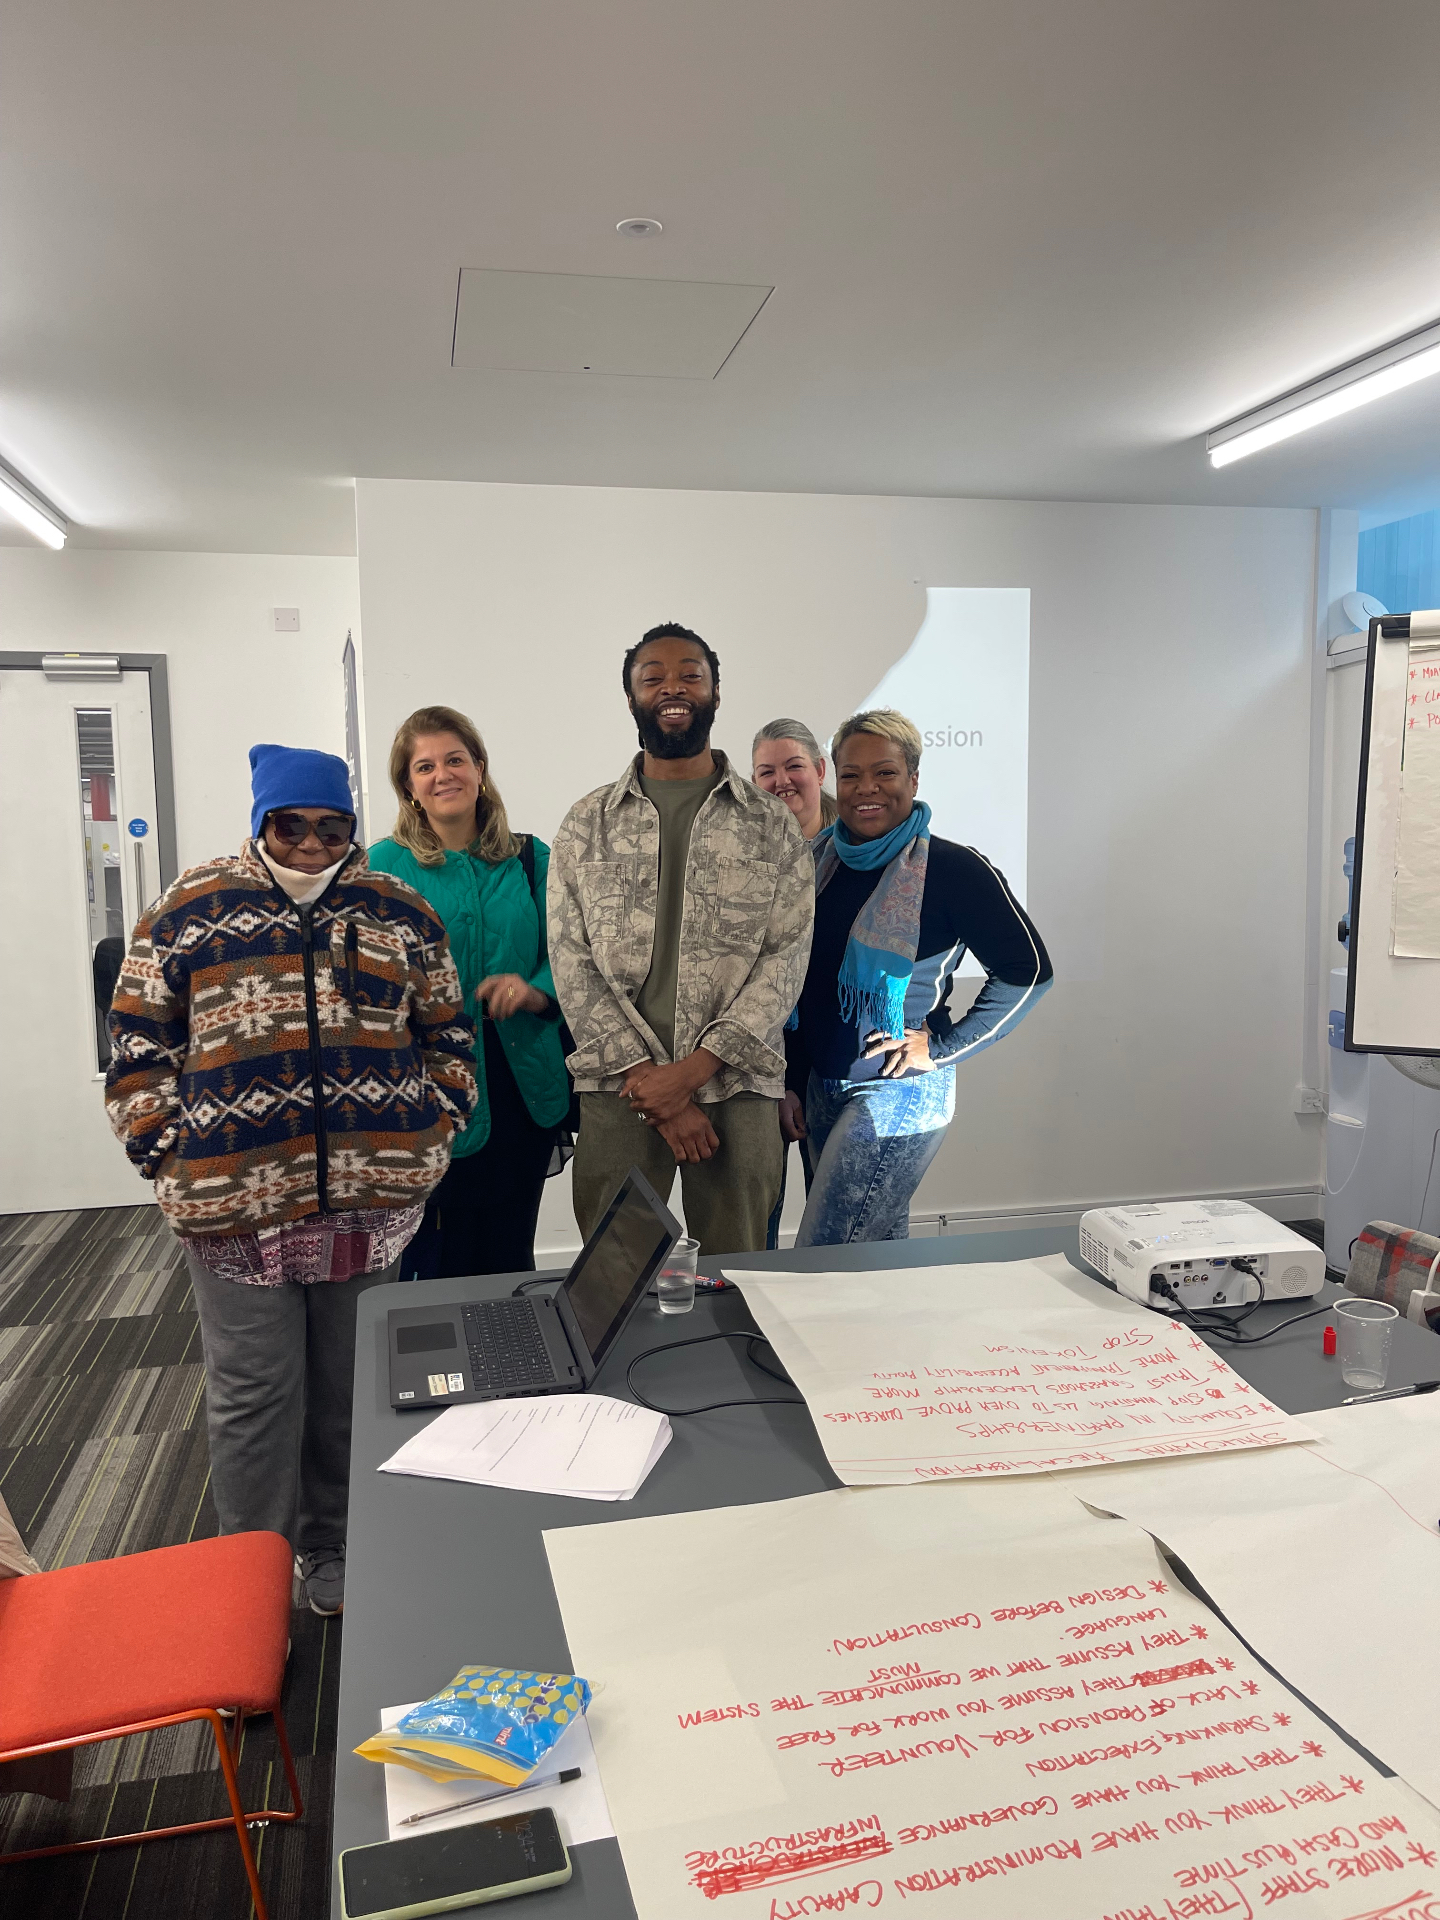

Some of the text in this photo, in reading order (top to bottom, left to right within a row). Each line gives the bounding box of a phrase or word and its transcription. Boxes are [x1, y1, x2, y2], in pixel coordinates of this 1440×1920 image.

[1102, 1328, 1153, 1350] STOP
[1146, 1368, 1210, 1390] TRUST
[863, 1387, 920, 1398] MORE
[906, 1400, 972, 1417] PROVE
[1068, 1584, 1146, 1609] DESIGN
[990, 1600, 1063, 1622] BEFORE
[1140, 1629, 1189, 1651] THEY
[1056, 1641, 1134, 1667] ASSUME
[867, 1662, 921, 1683] MUST
[969, 1666, 1001, 1682] WE
[1005, 1657, 1051, 1677] THAT
[1083, 1675, 1133, 1697] THEY
[1177, 1684, 1241, 1706] LACK
[770, 1695, 814, 1712] THE
[956, 1698, 994, 1717] YOU
[997, 1686, 1074, 1710] ASSUME
[1148, 1697, 1176, 1719] OF
[677, 1702, 760, 1729] SYSTEM
[883, 1707, 950, 1729] WORK
[1038, 1704, 1145, 1737] PROVISION
[495, 1726, 513, 1746] mint
[776, 1729, 836, 1750] FREE
[837, 1720, 882, 1737] FOR
[979, 1725, 1034, 1747] FOR
[897, 1747, 1299, 1845] THEY THINK YOU HAVE GOVERNANCE
[1279, 1780, 1346, 1809] THEY
[1208, 1795, 1286, 1825] THINK
[1164, 1809, 1212, 1834] YOU
[684, 1815, 881, 1870] INFRASTRUCTURE
[1090, 1820, 1159, 1853] HAVE
[1173, 1815, 1408, 1889] AND CASH PLUS TIME
[1327, 1845, 1404, 1881] MORE
[1260, 1867, 1329, 1907] STAFF
